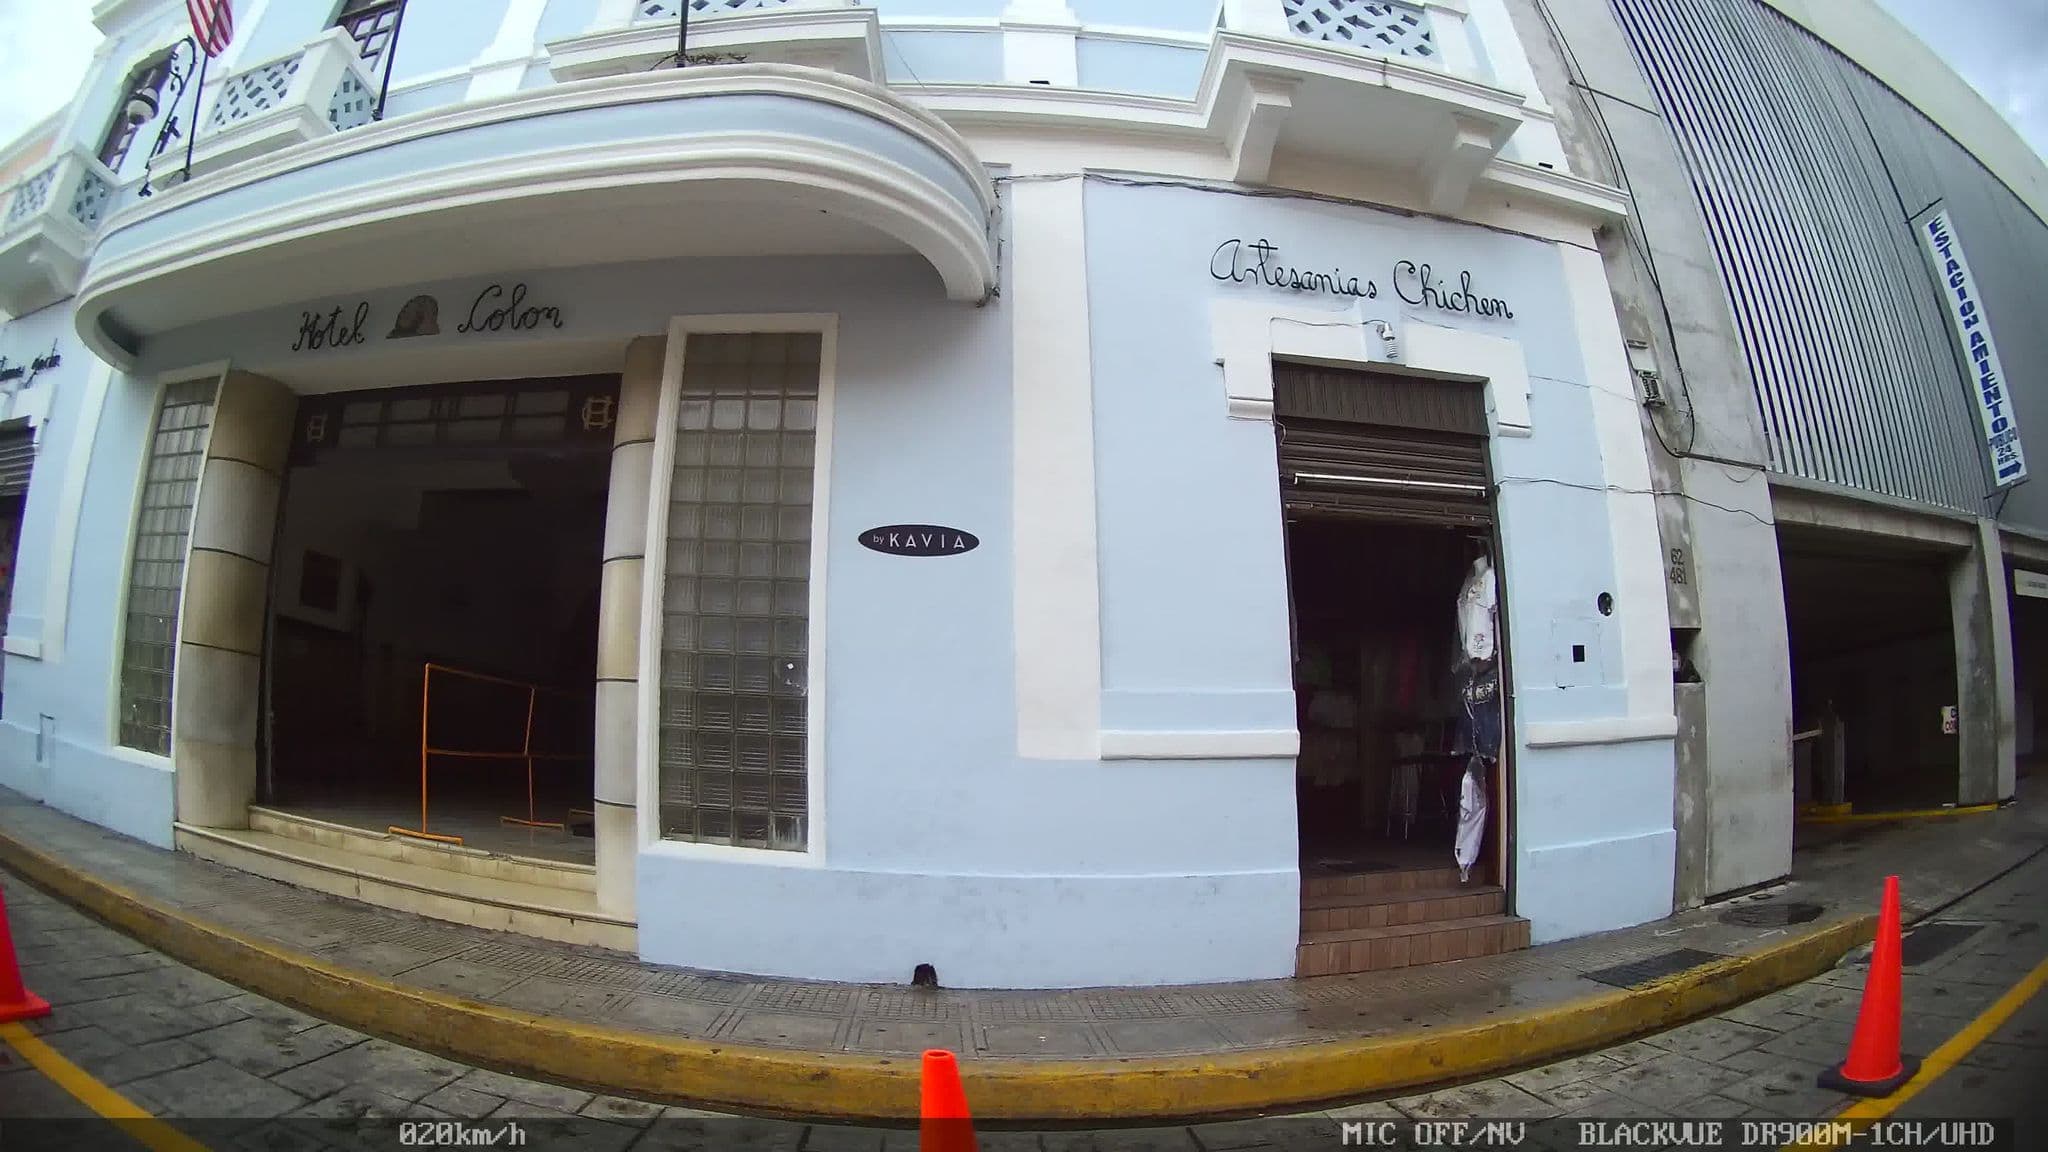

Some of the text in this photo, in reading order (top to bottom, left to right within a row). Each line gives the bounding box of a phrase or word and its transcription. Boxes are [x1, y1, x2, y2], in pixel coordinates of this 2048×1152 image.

[1210, 239, 1514, 319] Artesanias Chichen
[291, 283, 564, 351] Hotel Colon
[1928, 215, 2009, 434] ESTACIONAMIENTO
[873, 533, 966, 549] by KAVIA
[1671, 547, 1684, 566] 62
[1670, 566, 1688, 585] 481
